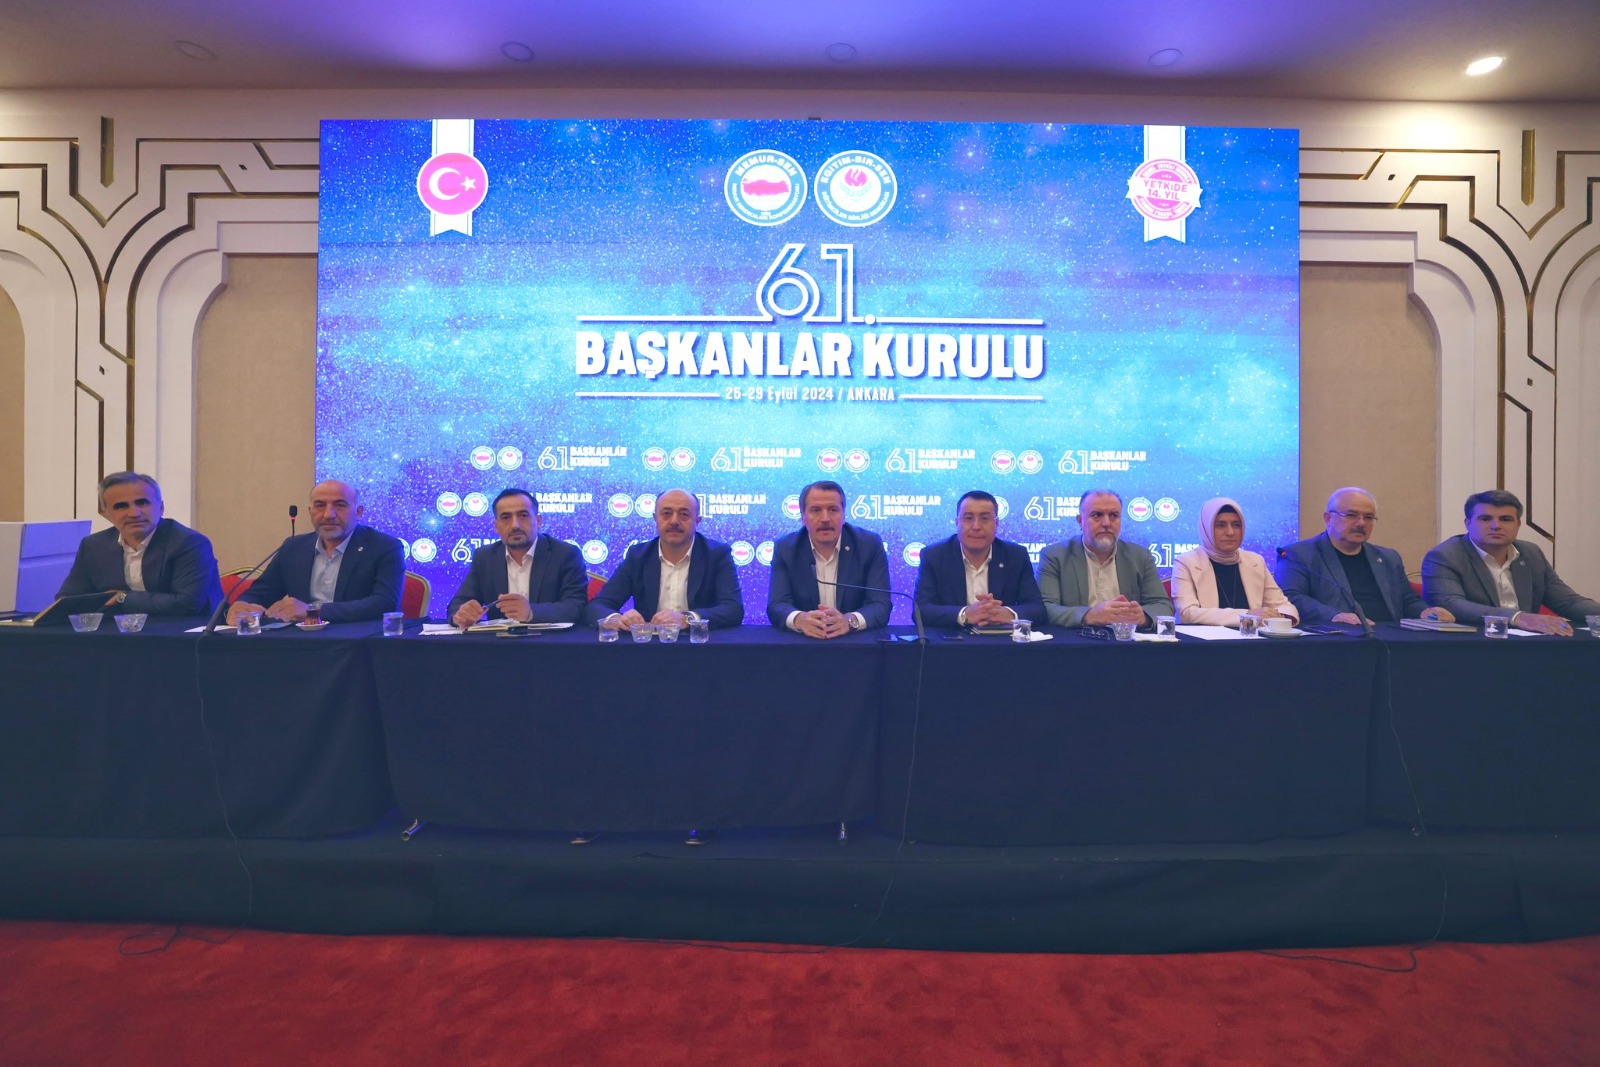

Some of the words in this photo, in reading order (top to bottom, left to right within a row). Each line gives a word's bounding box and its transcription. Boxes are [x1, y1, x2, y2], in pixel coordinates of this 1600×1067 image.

[735, 155, 798, 176] MEMUR-SEN
[1165, 190, 1181, 201] YIL
[755, 243, 876, 325] 61.
[575, 331, 853, 380] BAŞKANLAR
[863, 333, 1044, 379] KURULU
[767, 384, 799, 404] Eylül
[802, 387, 835, 401] 2024
[847, 387, 895, 401] ANKARA
